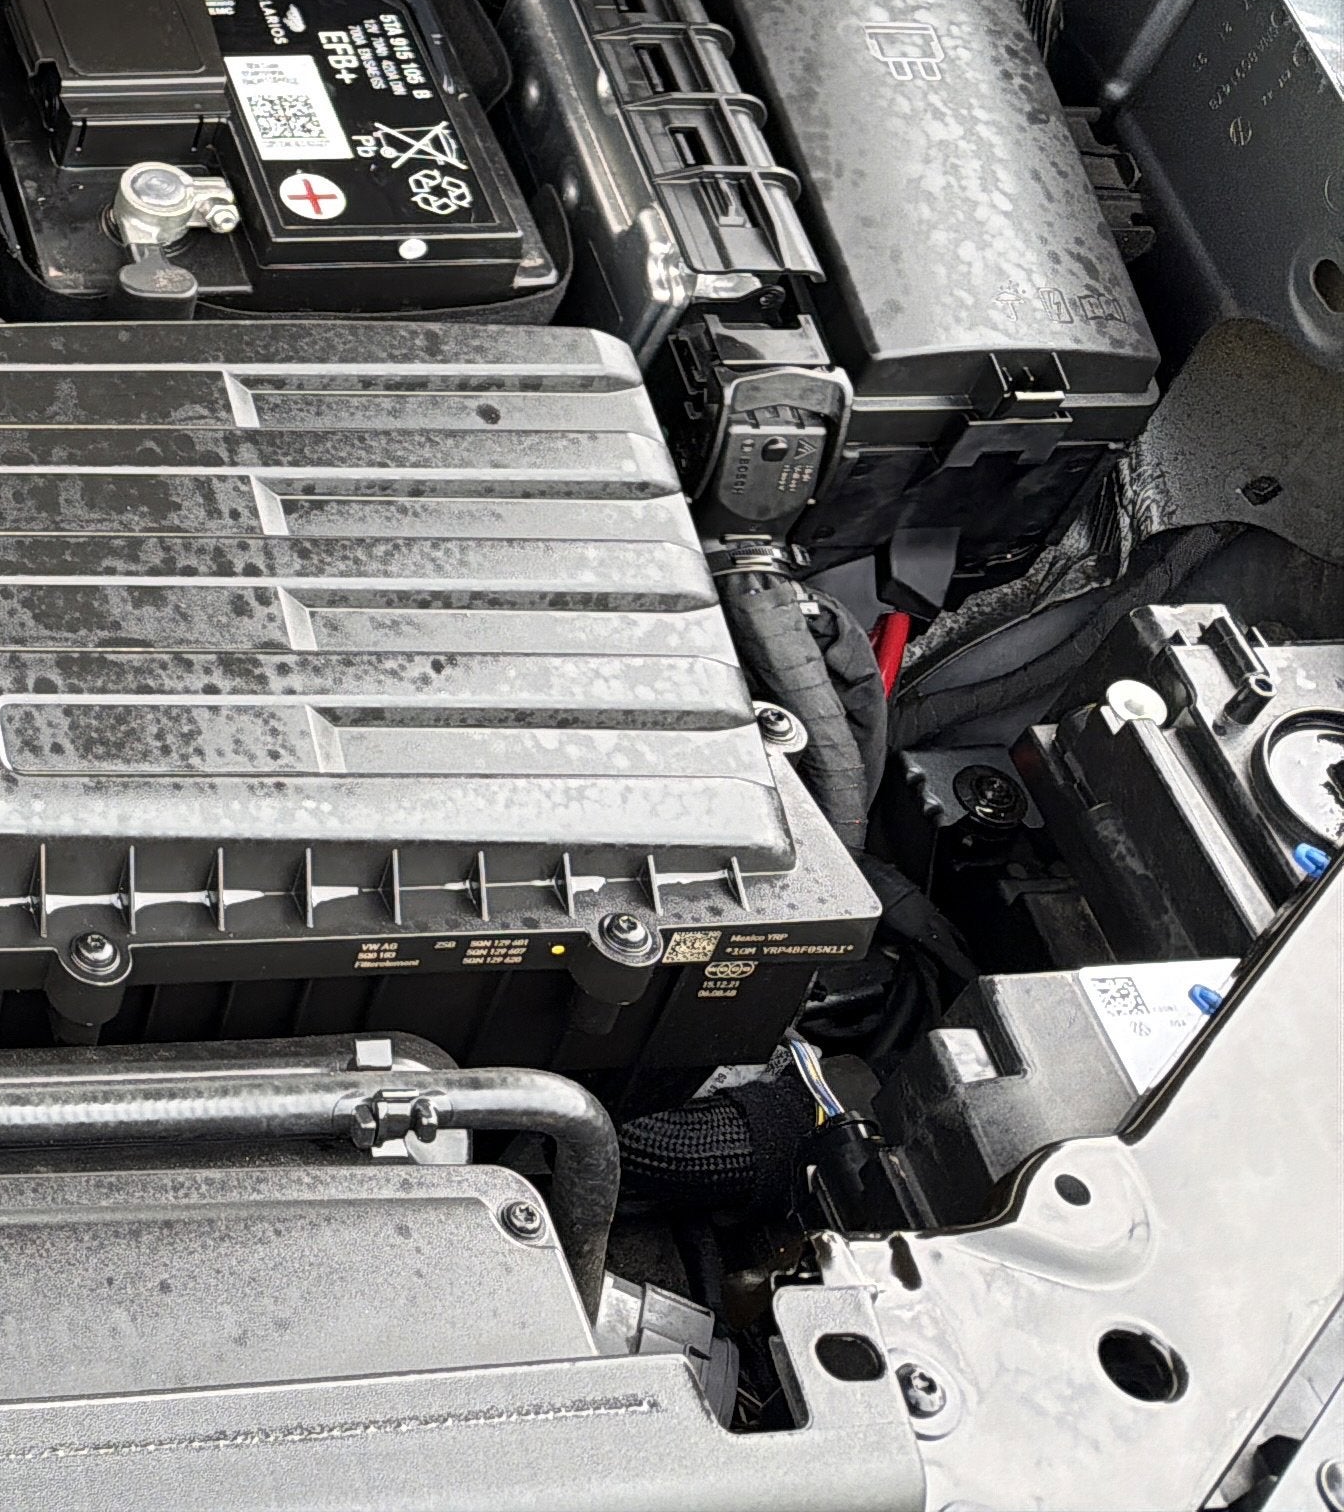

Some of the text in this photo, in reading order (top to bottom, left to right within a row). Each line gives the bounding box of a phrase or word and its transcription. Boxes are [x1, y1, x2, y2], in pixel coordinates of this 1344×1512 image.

[318, 31, 360, 85] EFB+
[390, 37, 415, 60] 915
[400, 62, 427, 85] 105
[351, 136, 379, 158] Pb
[732, 458, 751, 496] BOSCH
[361, 943, 379, 951] VW
[730, 933, 789, 943] Mexico YRP
